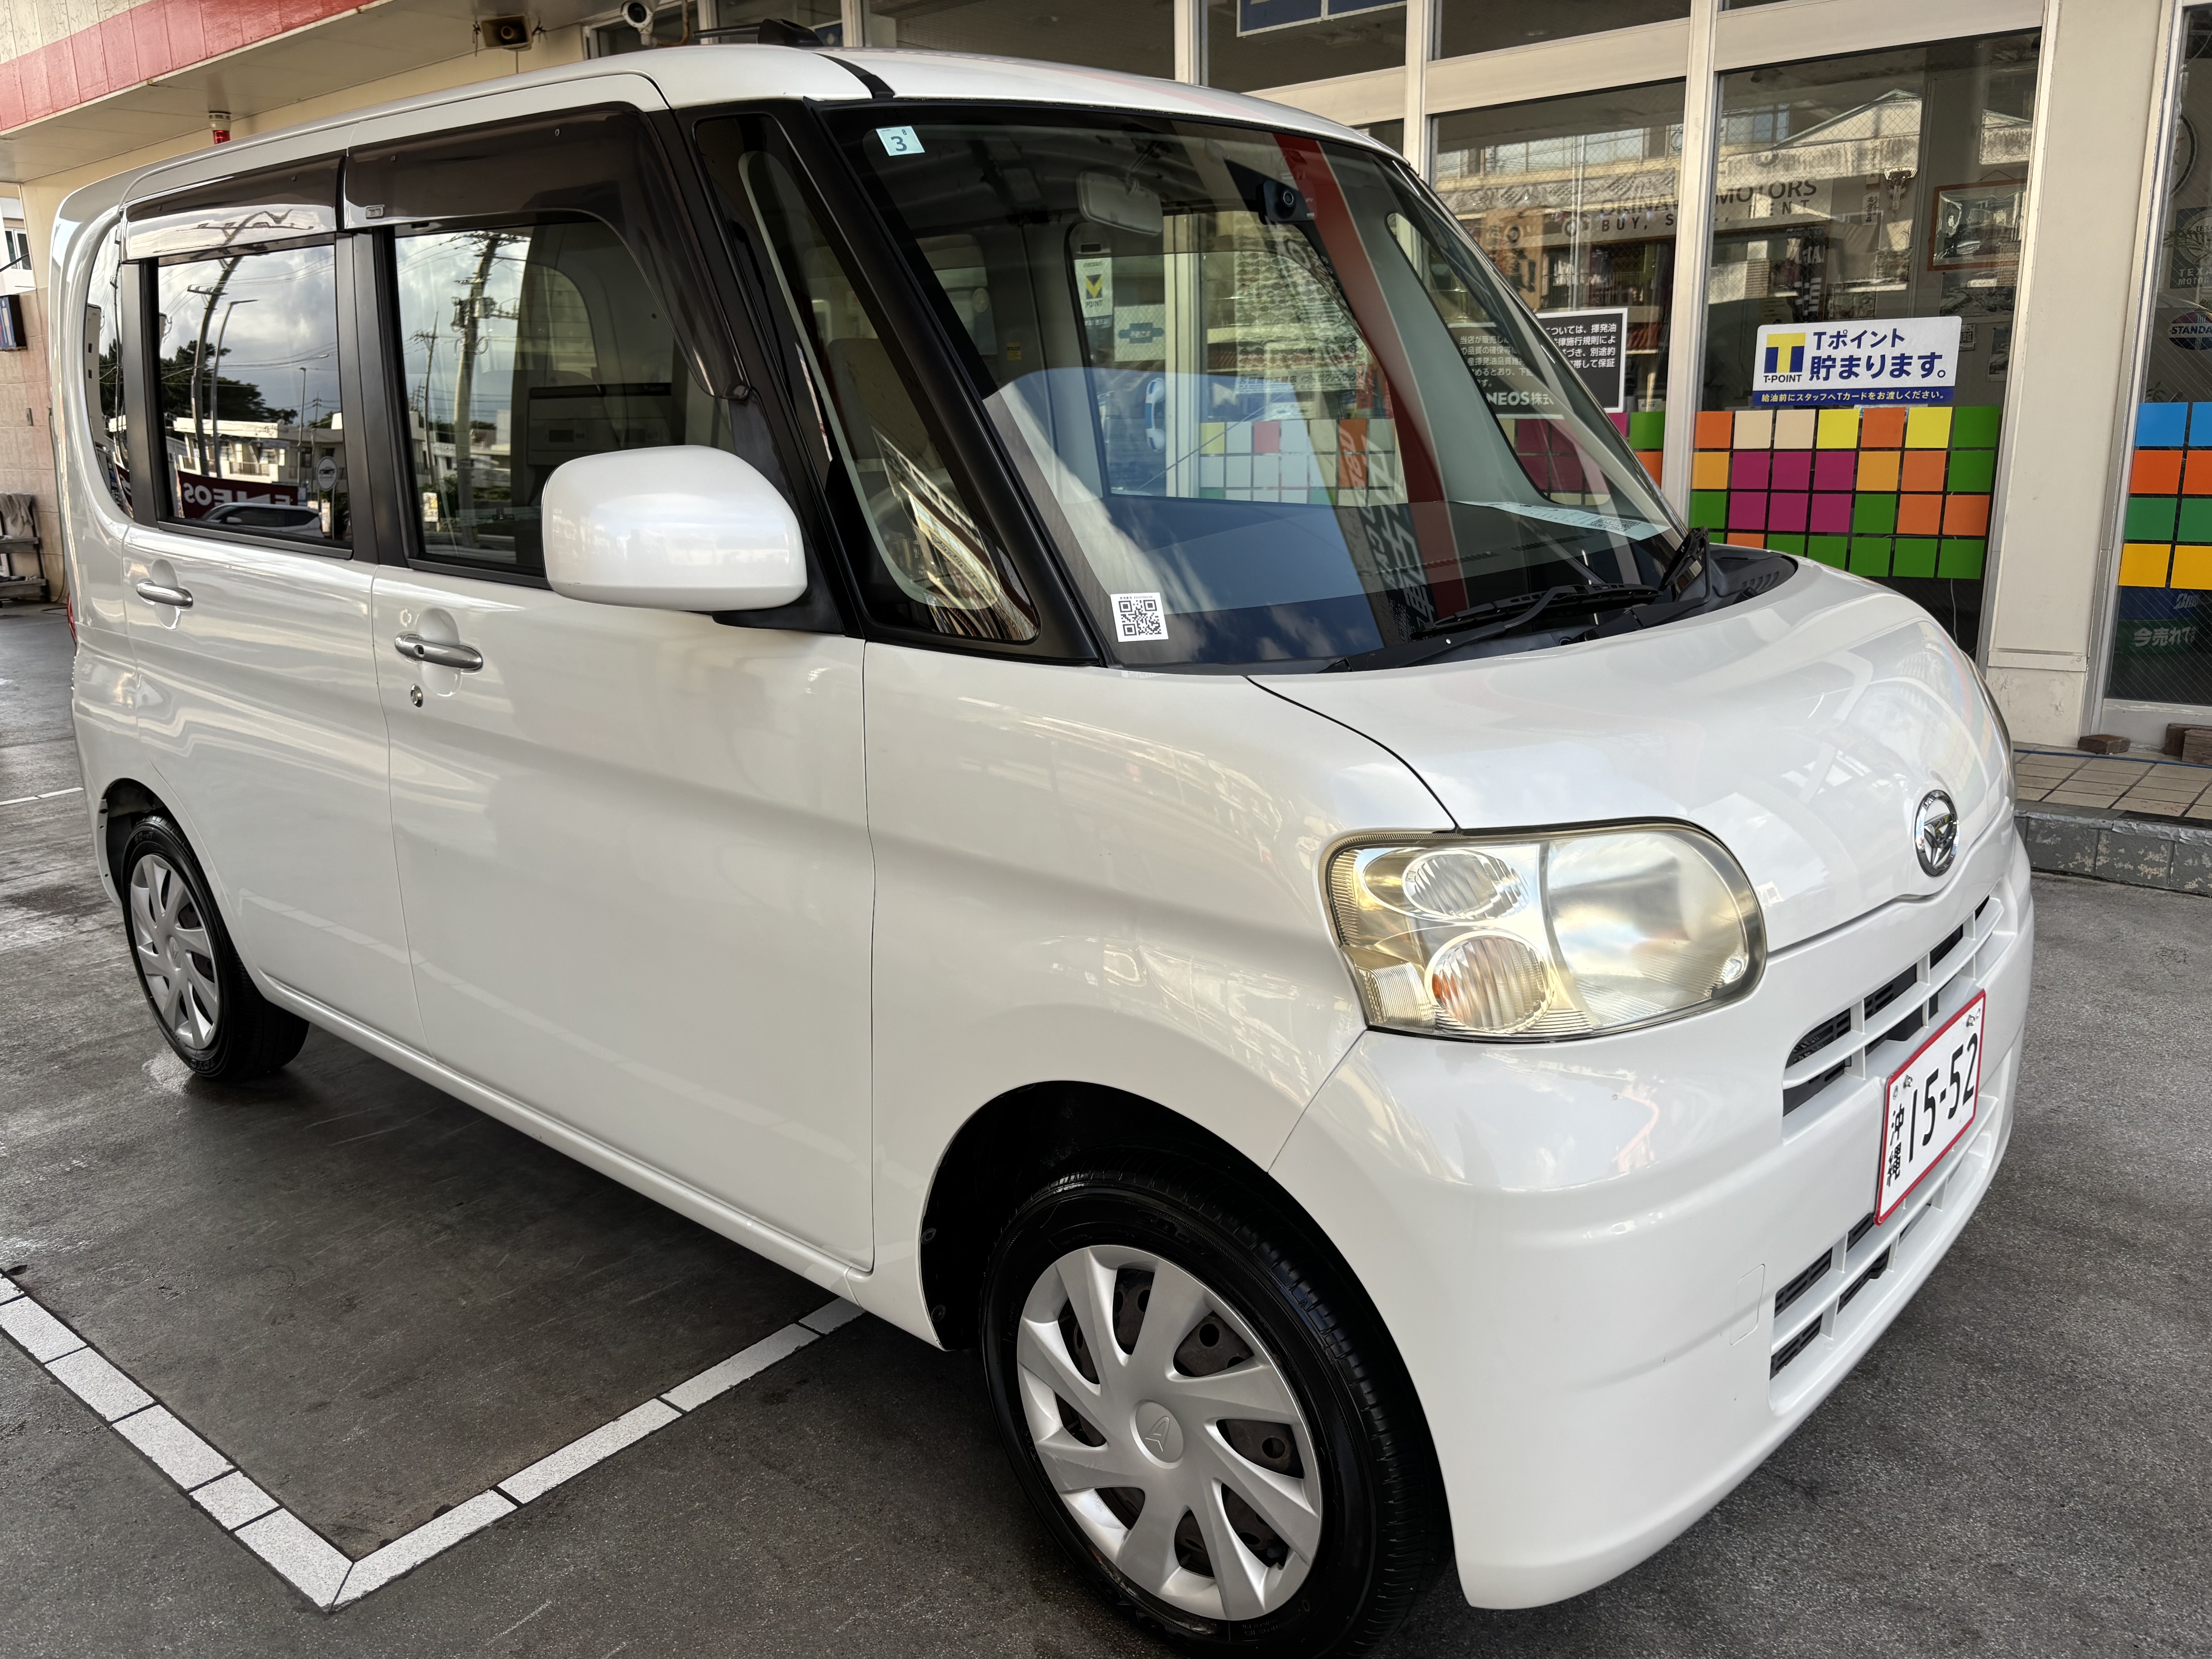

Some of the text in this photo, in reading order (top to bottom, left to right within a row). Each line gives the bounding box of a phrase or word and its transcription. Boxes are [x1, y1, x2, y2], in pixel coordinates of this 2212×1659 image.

[891, 136, 907, 152] 3
[1601, 216, 1648, 232] BUY,
[2178, 276, 2209, 286] MOTOR
[1813, 328, 1906, 351] Tポイント
[1570, 359, 1616, 369] 帯して保証
[1809, 351, 1946, 382] 貯まります。
[1763, 374, 1802, 384] T-POINT
[1761, 391, 1944, 403] 給油前にスタッフへTカードをお渡しください。
[1908, 1032, 1978, 1163] 15-52
[1886, 1103, 1905, 1187] 沖縄
